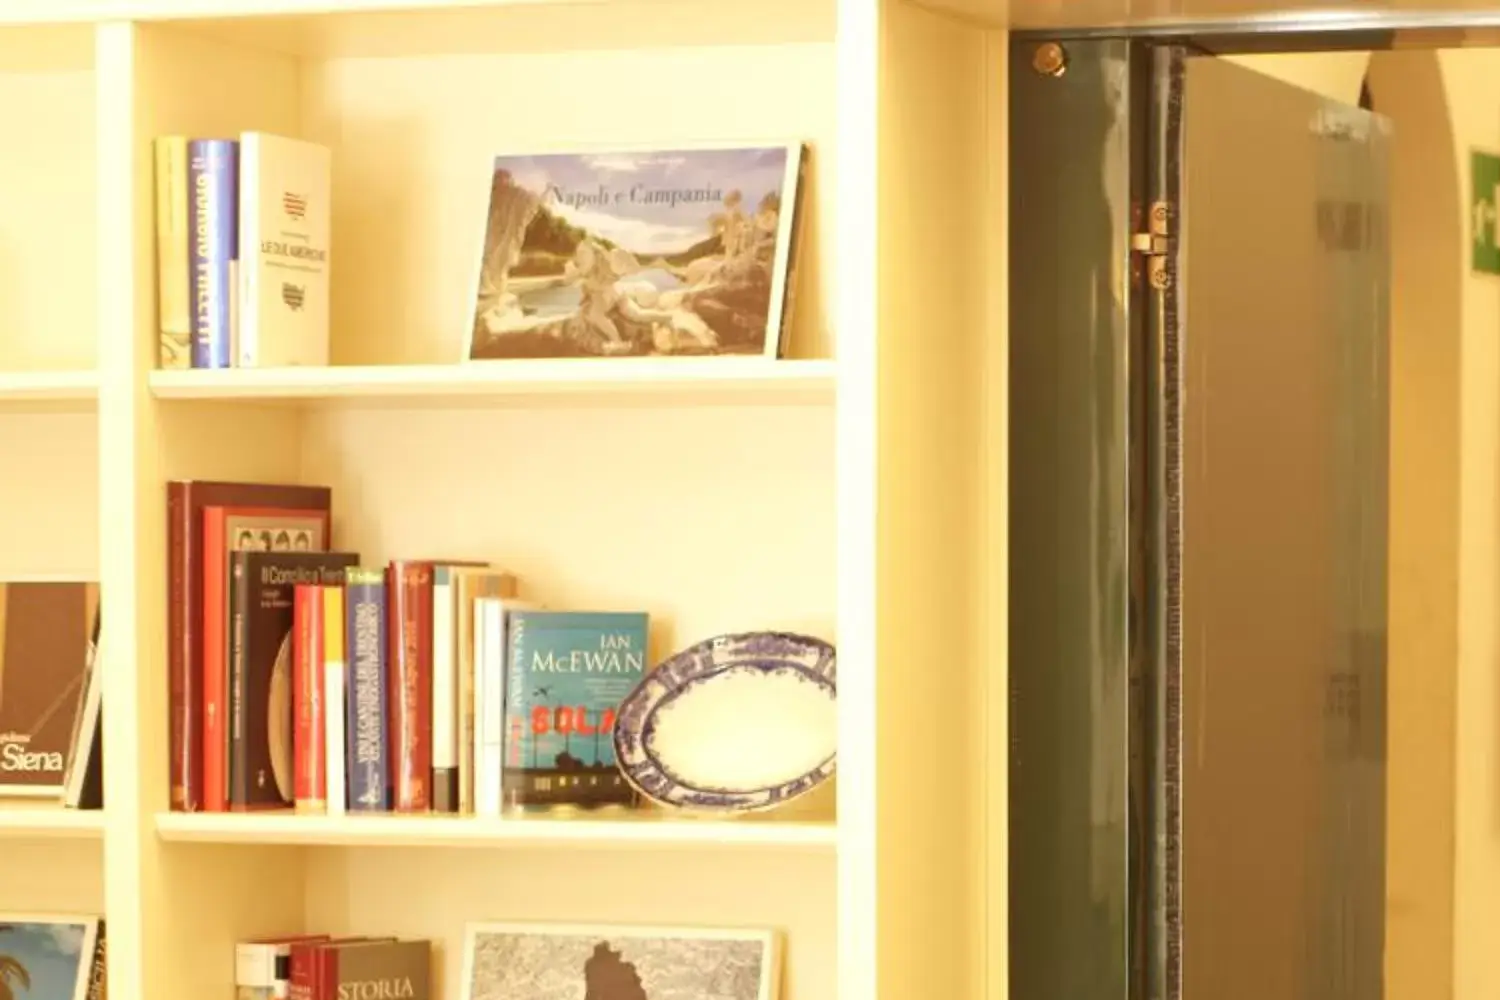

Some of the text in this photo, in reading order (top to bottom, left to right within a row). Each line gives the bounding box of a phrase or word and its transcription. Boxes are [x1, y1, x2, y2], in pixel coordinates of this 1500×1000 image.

[543, 182, 722, 210] Napoli e Campania
[601, 634, 631, 650] IAN
[532, 651, 643, 673] McEWAN
[1, 743, 63, 771] Siena
